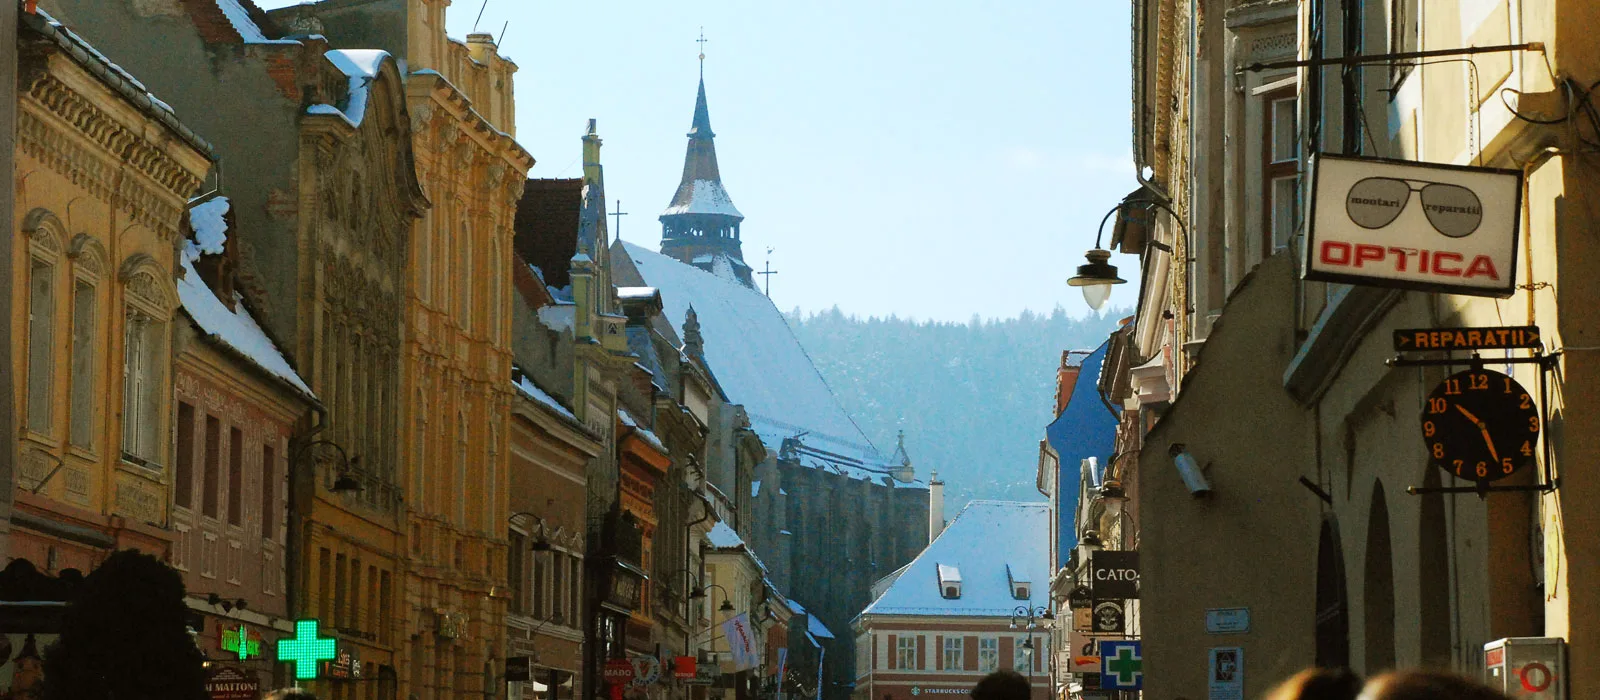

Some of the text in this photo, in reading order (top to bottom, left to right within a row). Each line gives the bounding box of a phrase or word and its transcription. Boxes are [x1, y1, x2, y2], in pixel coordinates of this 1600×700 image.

[1351, 196, 1481, 215] montari reparatii
[1320, 240, 1500, 280] OPTICA
[1415, 329, 1525, 348] REPARATII
[1444, 379, 1462, 395] 11
[1469, 374, 1489, 390] 12
[1503, 378, 1512, 394] 1
[1429, 397, 1447, 414] 10
[1519, 393, 1531, 410] 2
[1424, 421, 1435, 437] 9
[1529, 416, 1539, 432] 3
[1433, 443, 1445, 459] 8
[1520, 440, 1532, 456] 4
[1453, 459, 1464, 475] 7
[1476, 461, 1487, 477] 6
[1502, 458, 1513, 474] 5
[215, 682, 257, 692] MATTONI
